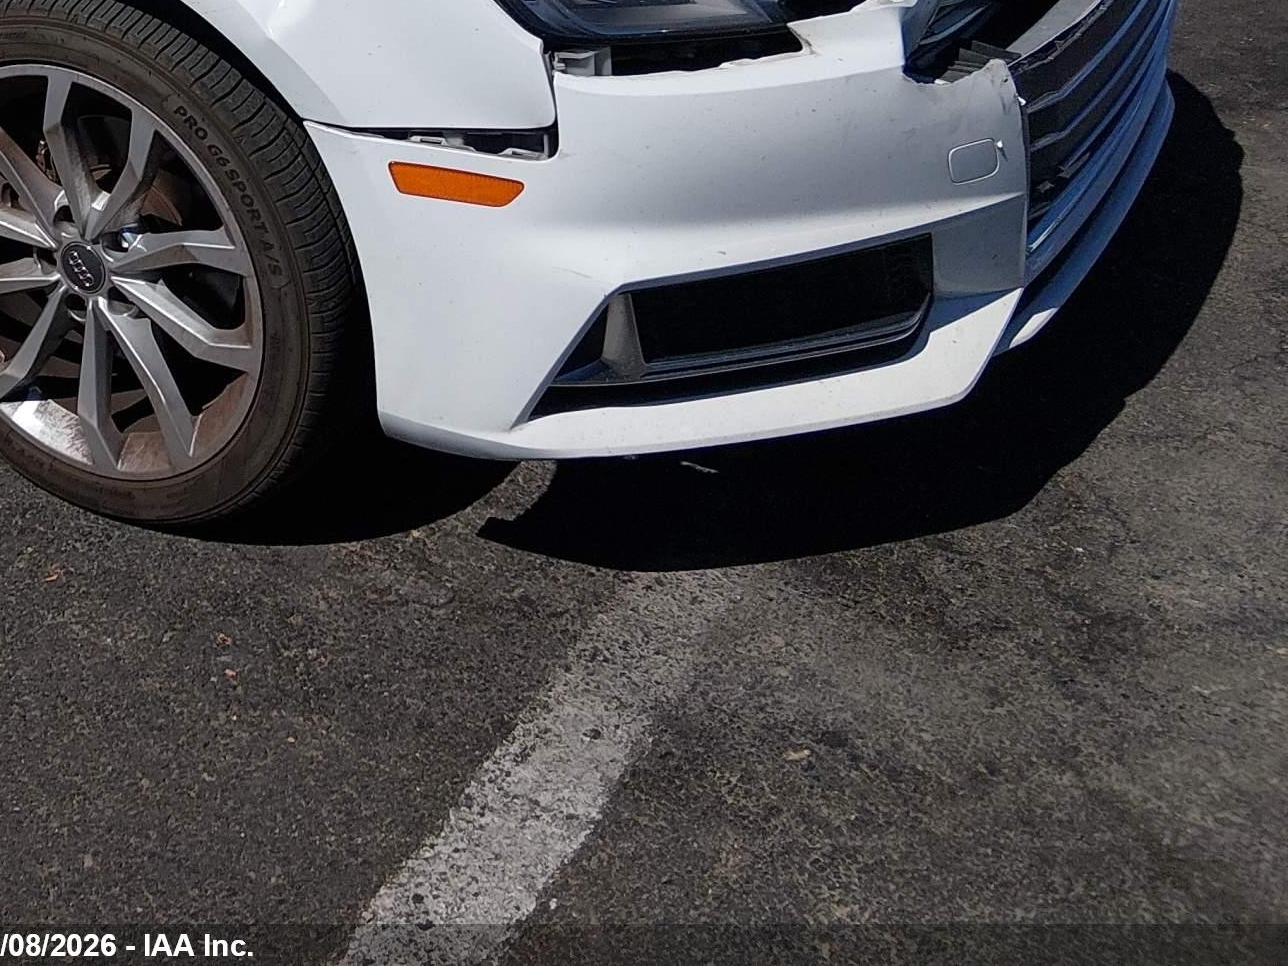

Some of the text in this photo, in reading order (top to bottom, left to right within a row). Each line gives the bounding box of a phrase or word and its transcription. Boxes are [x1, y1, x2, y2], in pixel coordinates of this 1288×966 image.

[173, 105, 283, 277] PRO G6 SPORT A/S
